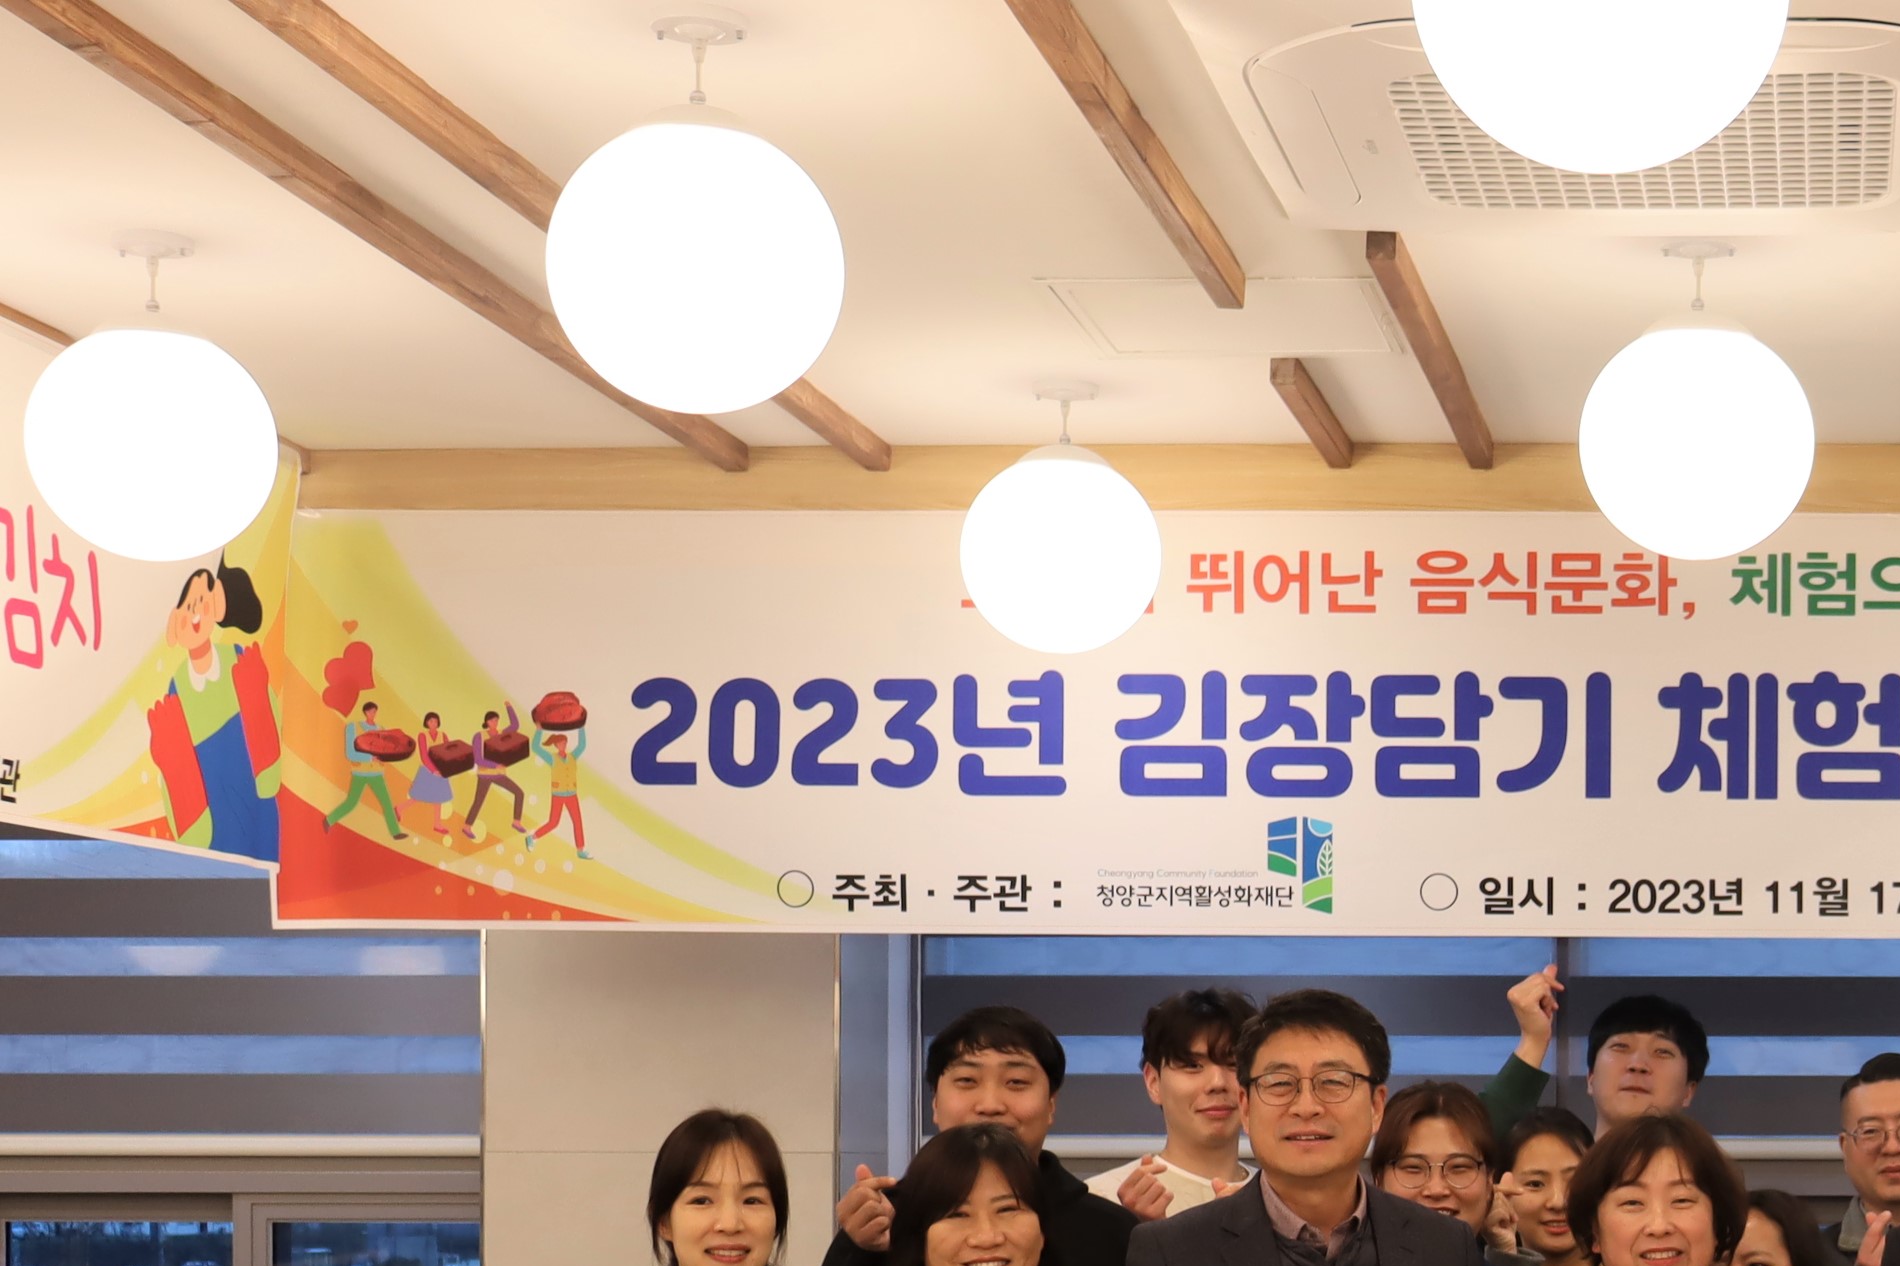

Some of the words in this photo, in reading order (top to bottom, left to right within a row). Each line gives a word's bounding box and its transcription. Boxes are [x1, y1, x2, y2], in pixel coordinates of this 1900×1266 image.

[1187, 551, 1383, 614] 뛰어난
[1410, 551, 1695, 619] 음식문화,
[631, 671, 1066, 796] 2023년
[1115, 671, 1612, 799] 김장담기
[1156, 868, 1206, 879] Community
[832, 874, 907, 912] 주최
[954, 875, 1032, 912] 주관
[1097, 884, 1293, 907] 청양군지역활성화재단
[1479, 877, 1553, 915] 일시
[1609, 878, 1742, 915] 2023년
[1766, 877, 1848, 916] 11월
